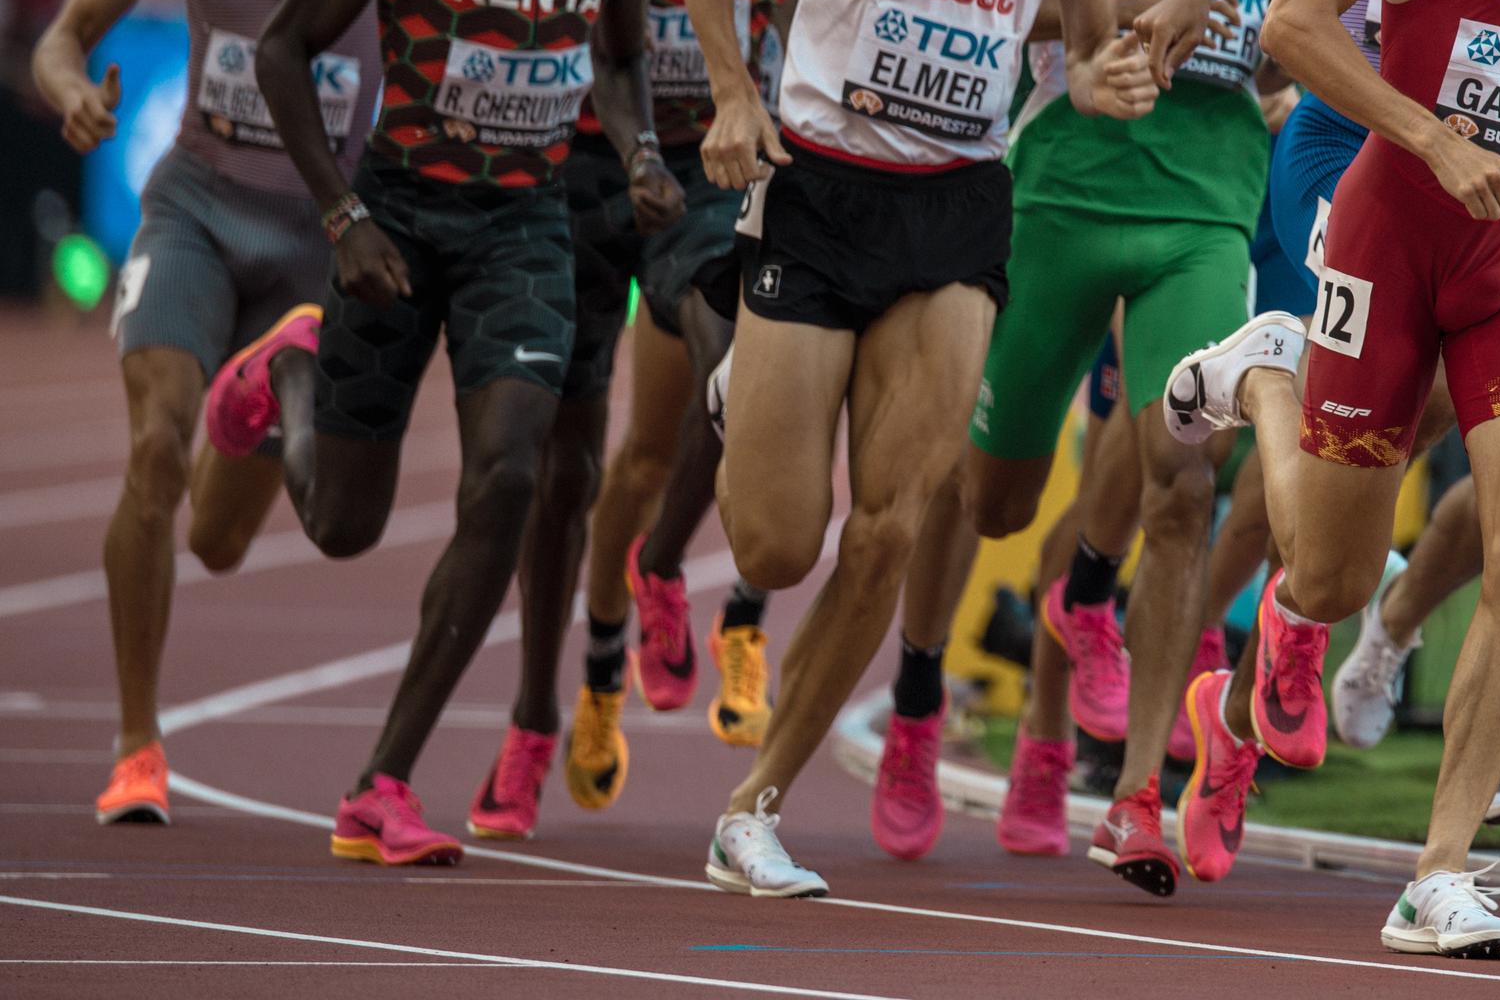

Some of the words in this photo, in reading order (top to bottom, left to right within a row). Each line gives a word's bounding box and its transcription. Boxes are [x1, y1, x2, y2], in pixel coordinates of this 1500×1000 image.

[499, 52, 583, 86] TDK
[912, 16, 1007, 70] TDK
[869, 49, 988, 112] ELMER
[1320, 280, 1355, 344] 12
[1320, 400, 1374, 418] ESP
